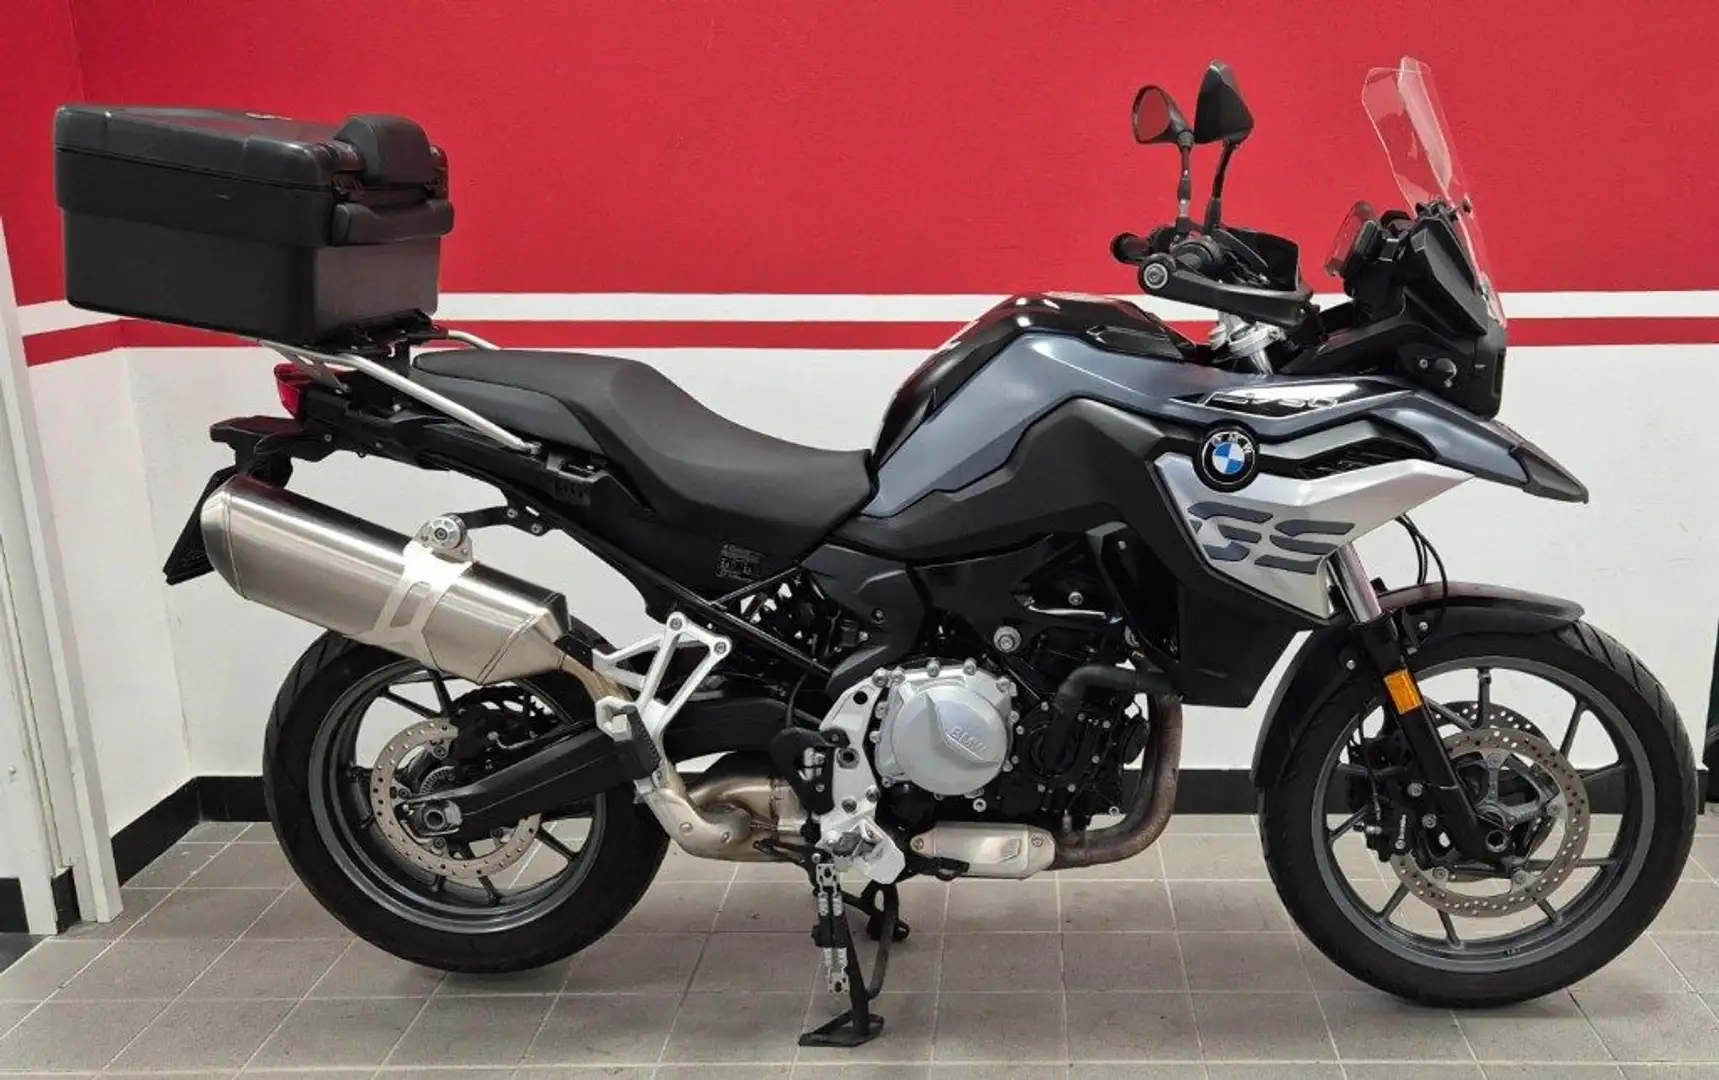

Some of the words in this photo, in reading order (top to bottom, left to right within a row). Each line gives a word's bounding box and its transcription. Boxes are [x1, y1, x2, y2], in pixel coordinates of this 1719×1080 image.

[1210, 432, 1253, 454] BMW
[1187, 501, 1356, 575] GS
[949, 725, 992, 755] BMW
